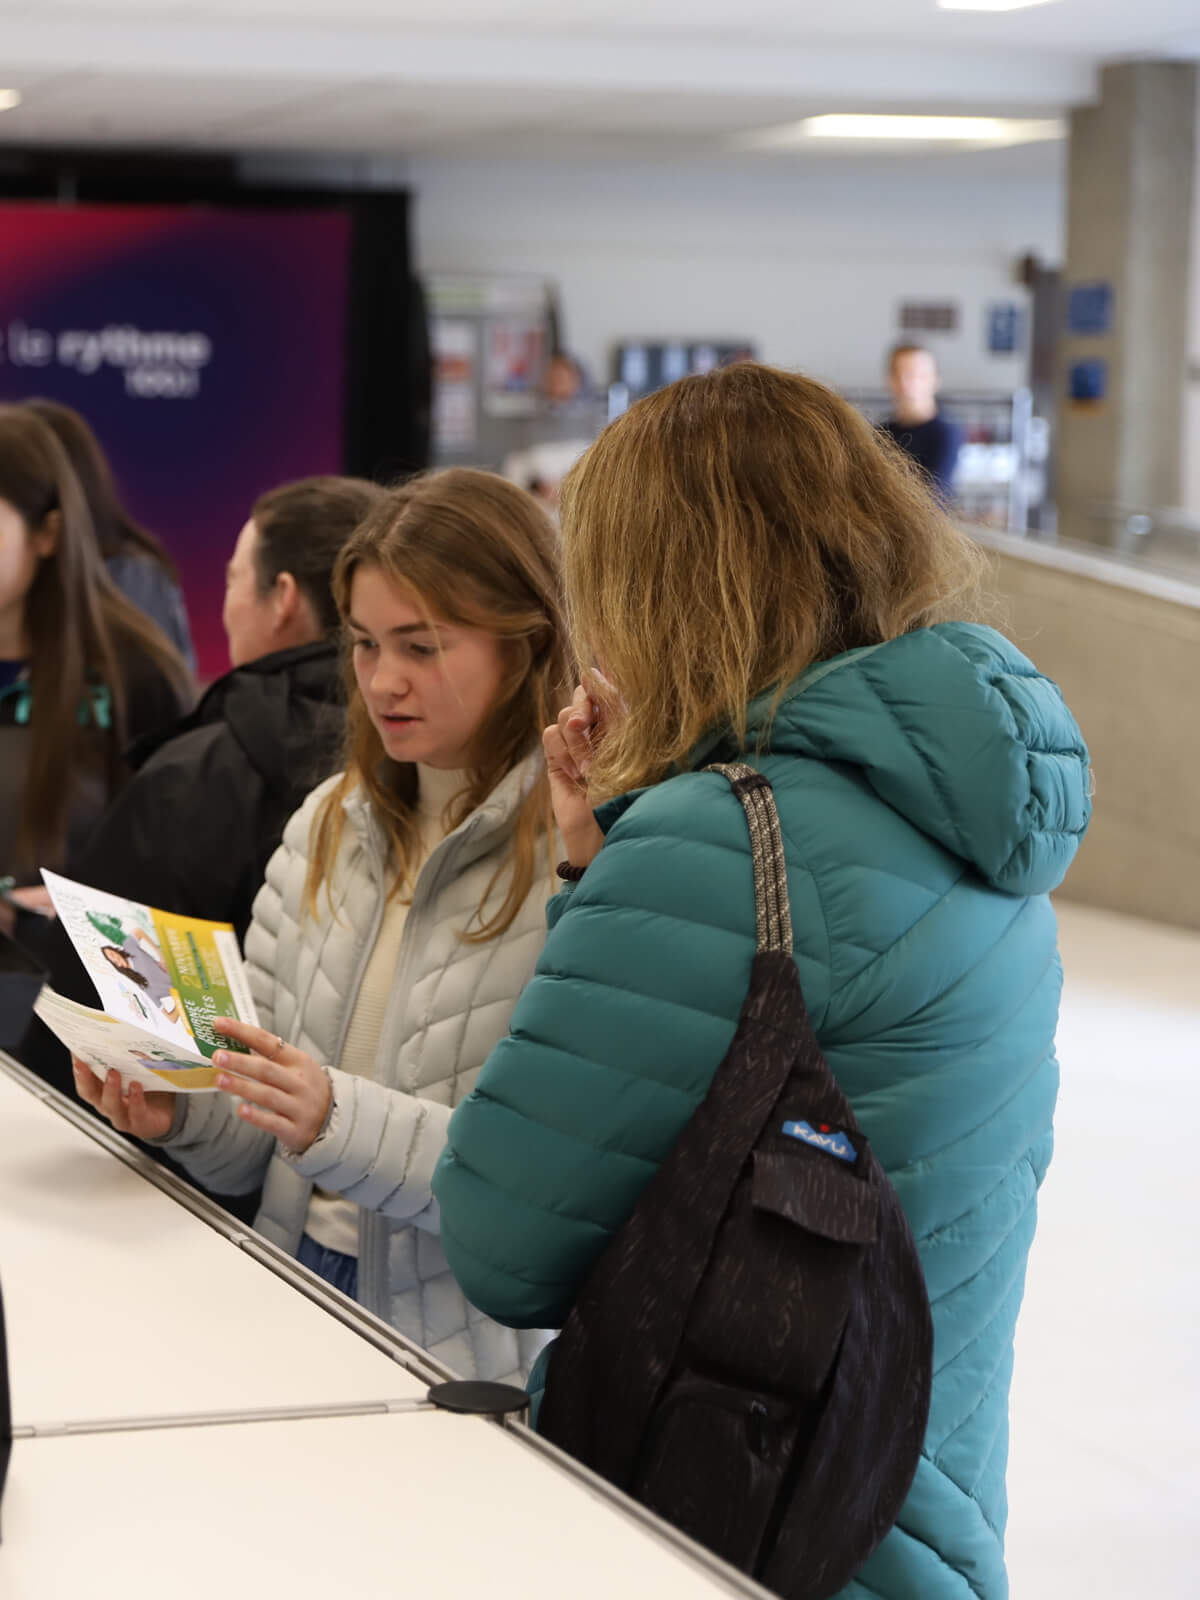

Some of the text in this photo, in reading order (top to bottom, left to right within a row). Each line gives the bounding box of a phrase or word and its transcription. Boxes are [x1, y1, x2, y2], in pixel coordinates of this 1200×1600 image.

[11, 320, 50, 364] le
[59, 326, 209, 372] rythme
[793, 1124, 847, 1155] KAVU
